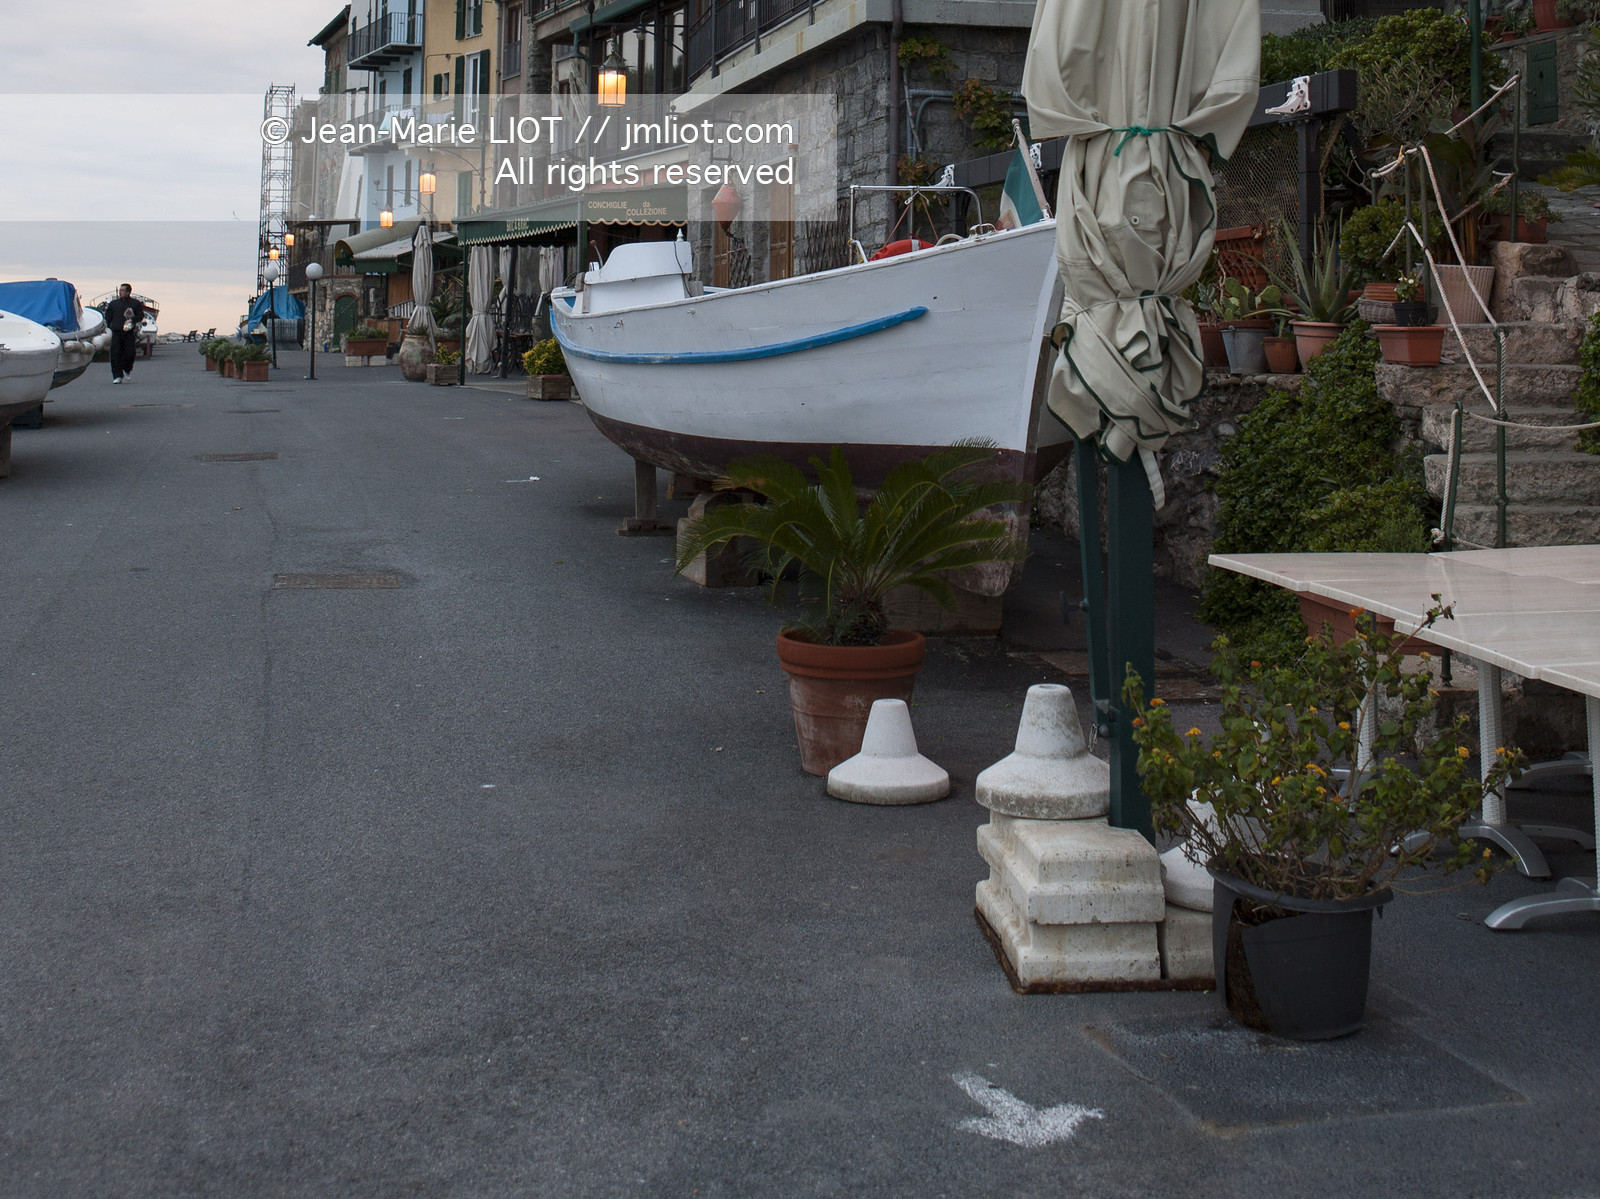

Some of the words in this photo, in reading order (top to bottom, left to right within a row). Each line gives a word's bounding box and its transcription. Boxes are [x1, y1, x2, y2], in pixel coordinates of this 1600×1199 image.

[587, 201, 628, 209] CONCHIGLIE
[642, 200, 651, 208] da
[626, 207, 667, 216] COLLEZIONE
